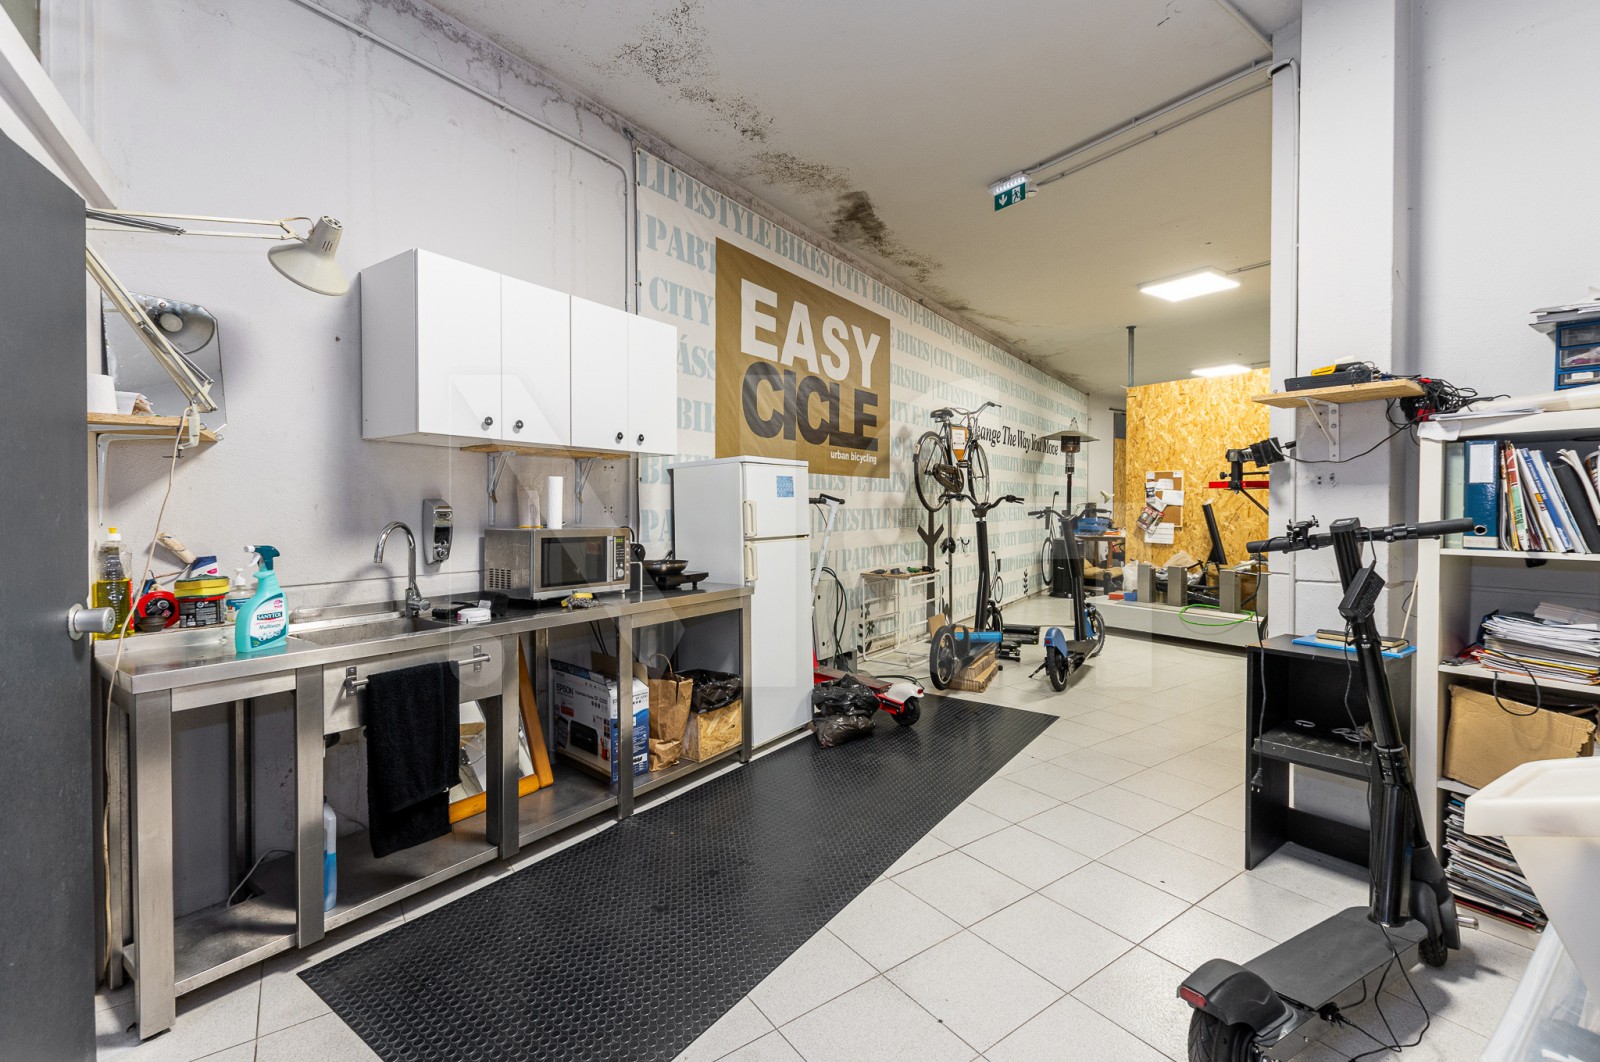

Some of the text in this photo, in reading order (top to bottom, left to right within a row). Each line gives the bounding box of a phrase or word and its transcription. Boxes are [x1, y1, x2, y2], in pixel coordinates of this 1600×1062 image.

[638, 149, 771, 251] LIFESTYLE
[774, 224, 833, 282] BIKES
[837, 259, 873, 302] CITY
[875, 281, 908, 319] BIKES
[647, 272, 713, 327] CITY
[889, 362, 930, 396] ERSHIP
[741, 278, 881, 389] EASY
[896, 328, 929, 363] BIKES
[933, 345, 954, 372] CITY
[955, 355, 980, 383] BIKES
[742, 361, 879, 451] CICLE
[830, 450, 877, 465] urban bicycling
[1001, 424, 1016, 447] The
[1016, 428, 1031, 454] Way
[258, 612, 283, 620] SANYTOL
[556, 683, 574, 695] EPSON
